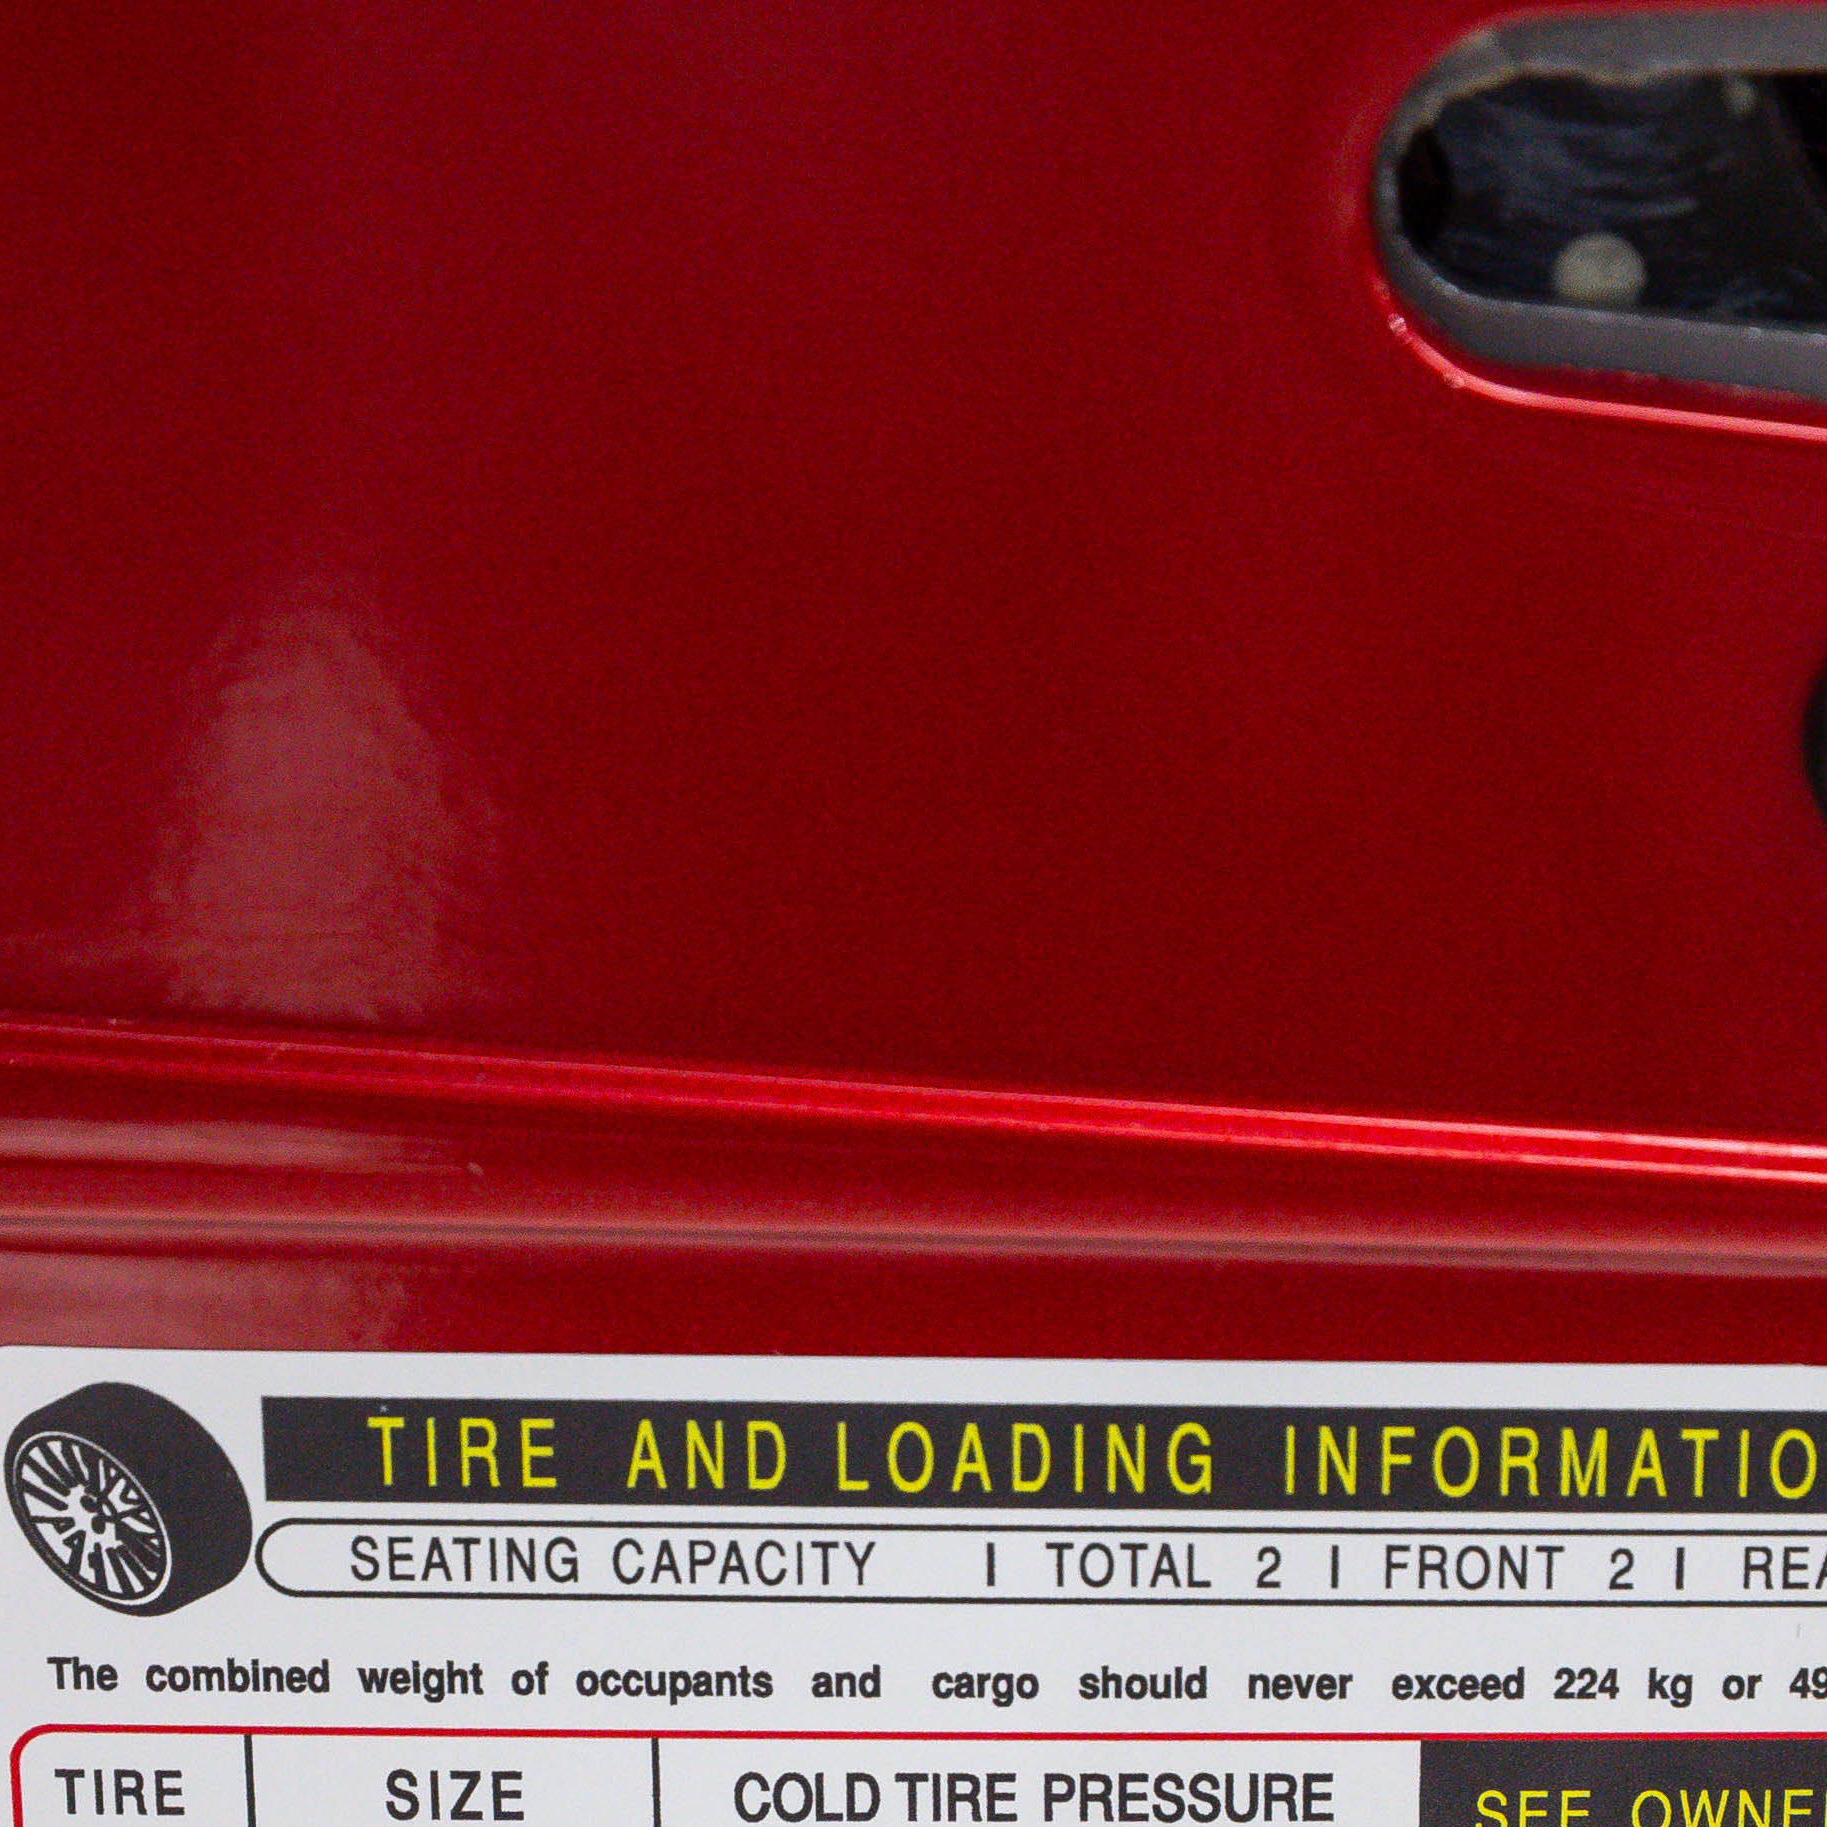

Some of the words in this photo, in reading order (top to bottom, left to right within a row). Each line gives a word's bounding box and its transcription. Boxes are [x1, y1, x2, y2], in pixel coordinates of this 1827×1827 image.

[365, 1415, 558, 1489] TIRE
[626, 1418, 787, 1492] AND
[836, 1420, 1213, 1495] LOADING
[351, 1535, 579, 1584] SEATING
[612, 1538, 876, 1587] CAPACITY
[1045, 1542, 1212, 1589] TOTAL
[1256, 1546, 1281, 1589] 2
[1385, 1544, 1565, 1590] FRONT
[1609, 1548, 1634, 1590] 2
[46, 1656, 118, 1692] The
[145, 1657, 330, 1694] combined
[356, 1660, 484, 1703] weight
[511, 1660, 549, 1696] of
[576, 1665, 774, 1706] occupants
[811, 1664, 881, 1699] and
[932, 1671, 1039, 1708] cargo
[1078, 1665, 1208, 1700] should
[1248, 1673, 1353, 1701] never
[1391, 1666, 1525, 1701] exceed
[1553, 1667, 1620, 1700] 224
[1648, 1667, 1693, 1708] kg
[1722, 1674, 1763, 1701] or
[54, 1768, 185, 1816] TIRE
[386, 1768, 525, 1821] SIZE
[734, 1771, 881, 1823] COLD
[894, 1772, 1018, 1823] TIRE
[1043, 1772, 1334, 1824] PRESSURE
